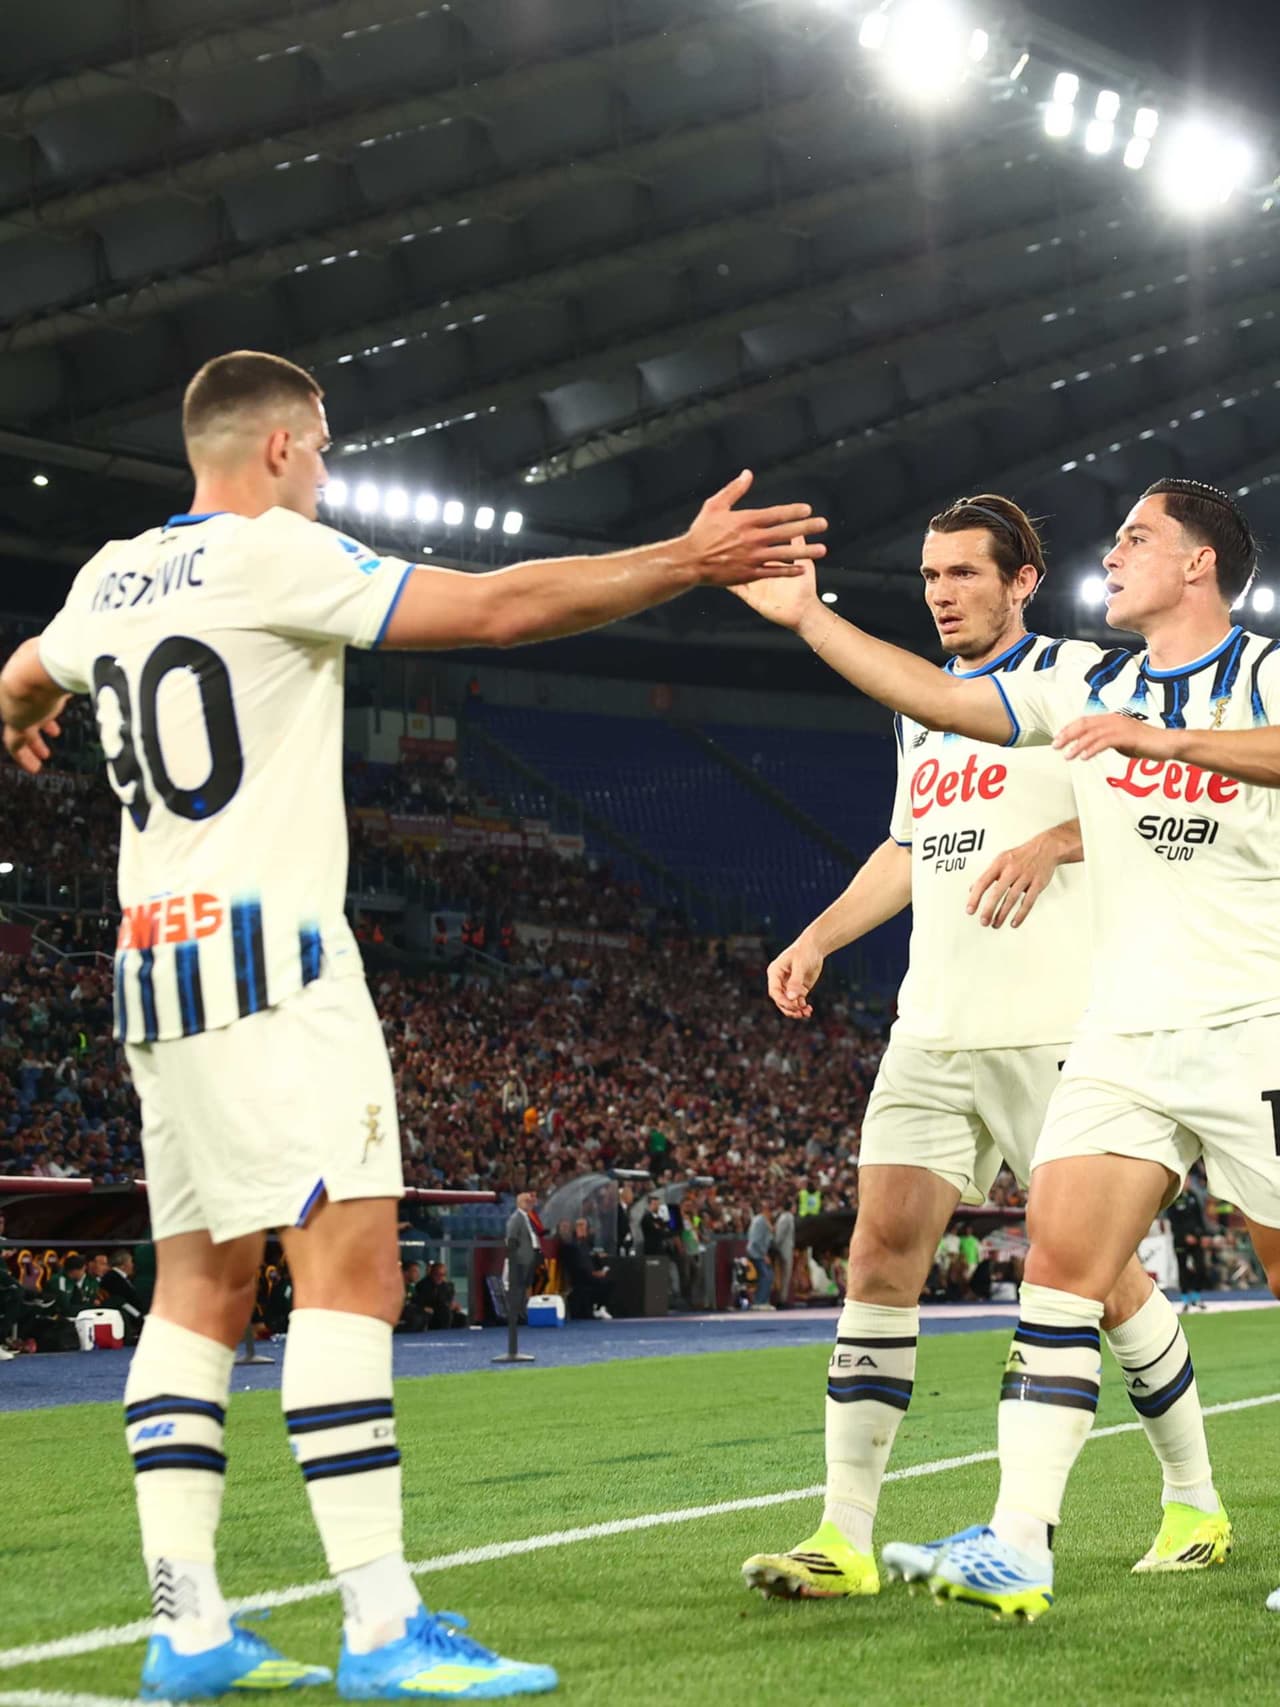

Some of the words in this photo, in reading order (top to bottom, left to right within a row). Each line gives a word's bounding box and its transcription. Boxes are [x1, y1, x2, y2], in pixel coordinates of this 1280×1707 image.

[93, 635, 244, 833] 90
[1106, 757, 1240, 804] Lete
[935, 857, 966, 874] FUN
[1154, 845, 1194, 861] FUN
